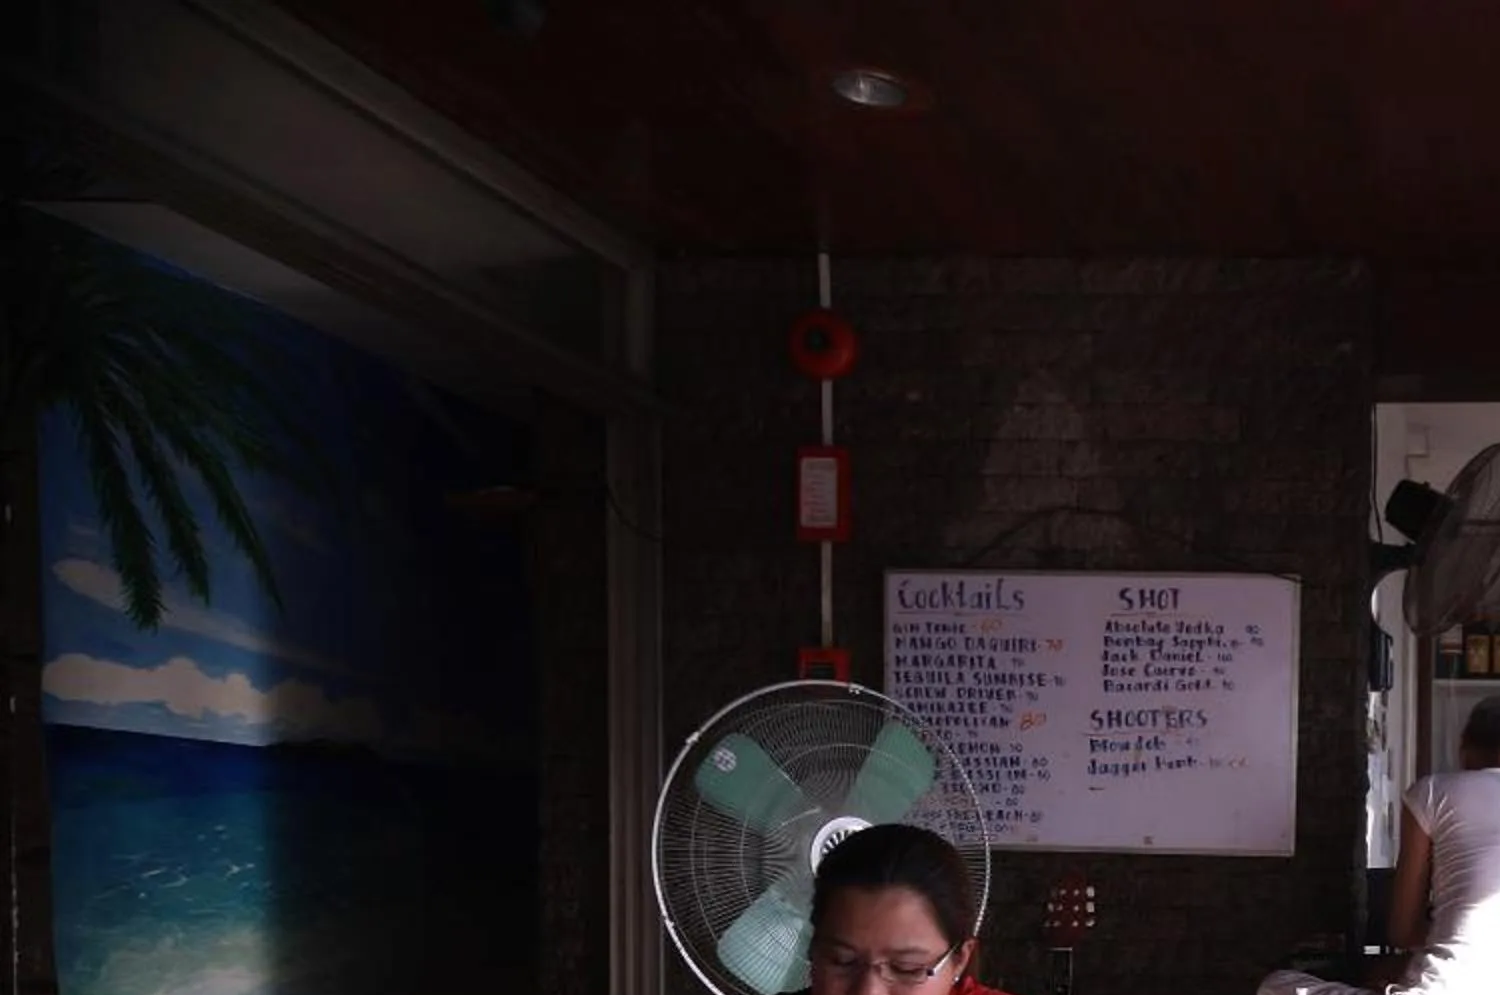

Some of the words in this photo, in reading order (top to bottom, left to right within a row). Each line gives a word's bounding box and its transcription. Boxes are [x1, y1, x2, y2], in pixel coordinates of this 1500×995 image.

[1119, 587, 1180, 610] SHOT
[895, 637, 957, 650] MANGO
[895, 654, 996, 669] MARGARITA
[1102, 648, 1138, 662] Jack
[1102, 663, 1136, 677] Jose
[894, 671, 966, 685] TEQUILA
[973, 672, 1047, 687] SUNRISE
[957, 686, 1017, 701] DRIVER
[1090, 708, 1208, 730] SHOOTERS
